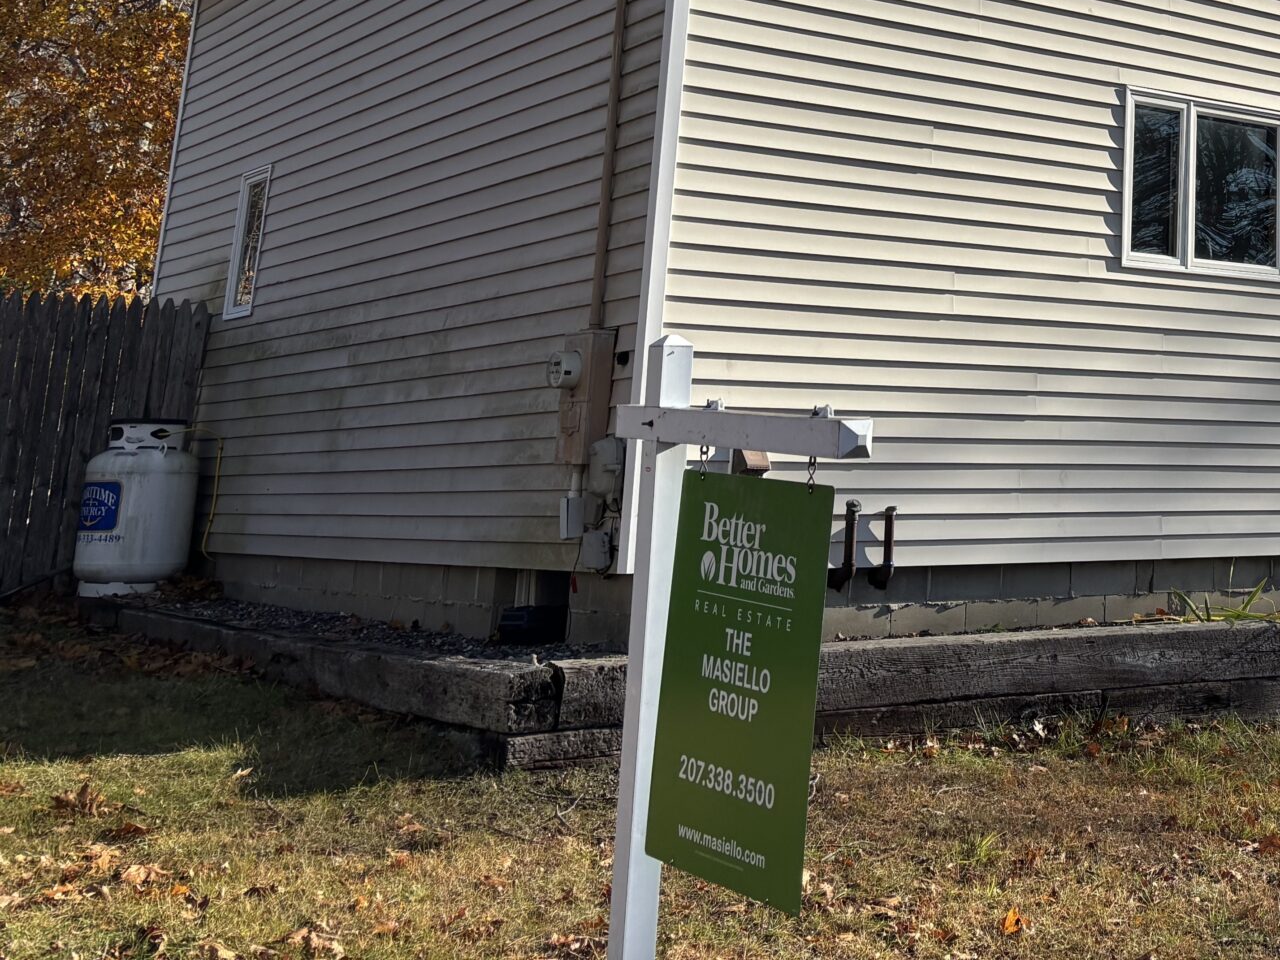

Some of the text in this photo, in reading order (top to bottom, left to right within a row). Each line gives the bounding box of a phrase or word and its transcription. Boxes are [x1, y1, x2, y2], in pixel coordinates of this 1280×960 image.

[700, 501, 767, 550] Better
[716, 544, 797, 588] Homes
[740, 578, 795, 599] and Gardens
[694, 599, 792, 632] REAL ESTATE
[725, 627, 753, 657] THE
[701, 653, 771, 694] MASIELLO
[708, 688, 758, 723] GROUP
[678, 754, 775, 809] 207.338.3500
[678, 823, 766, 869] www.masiello.com
